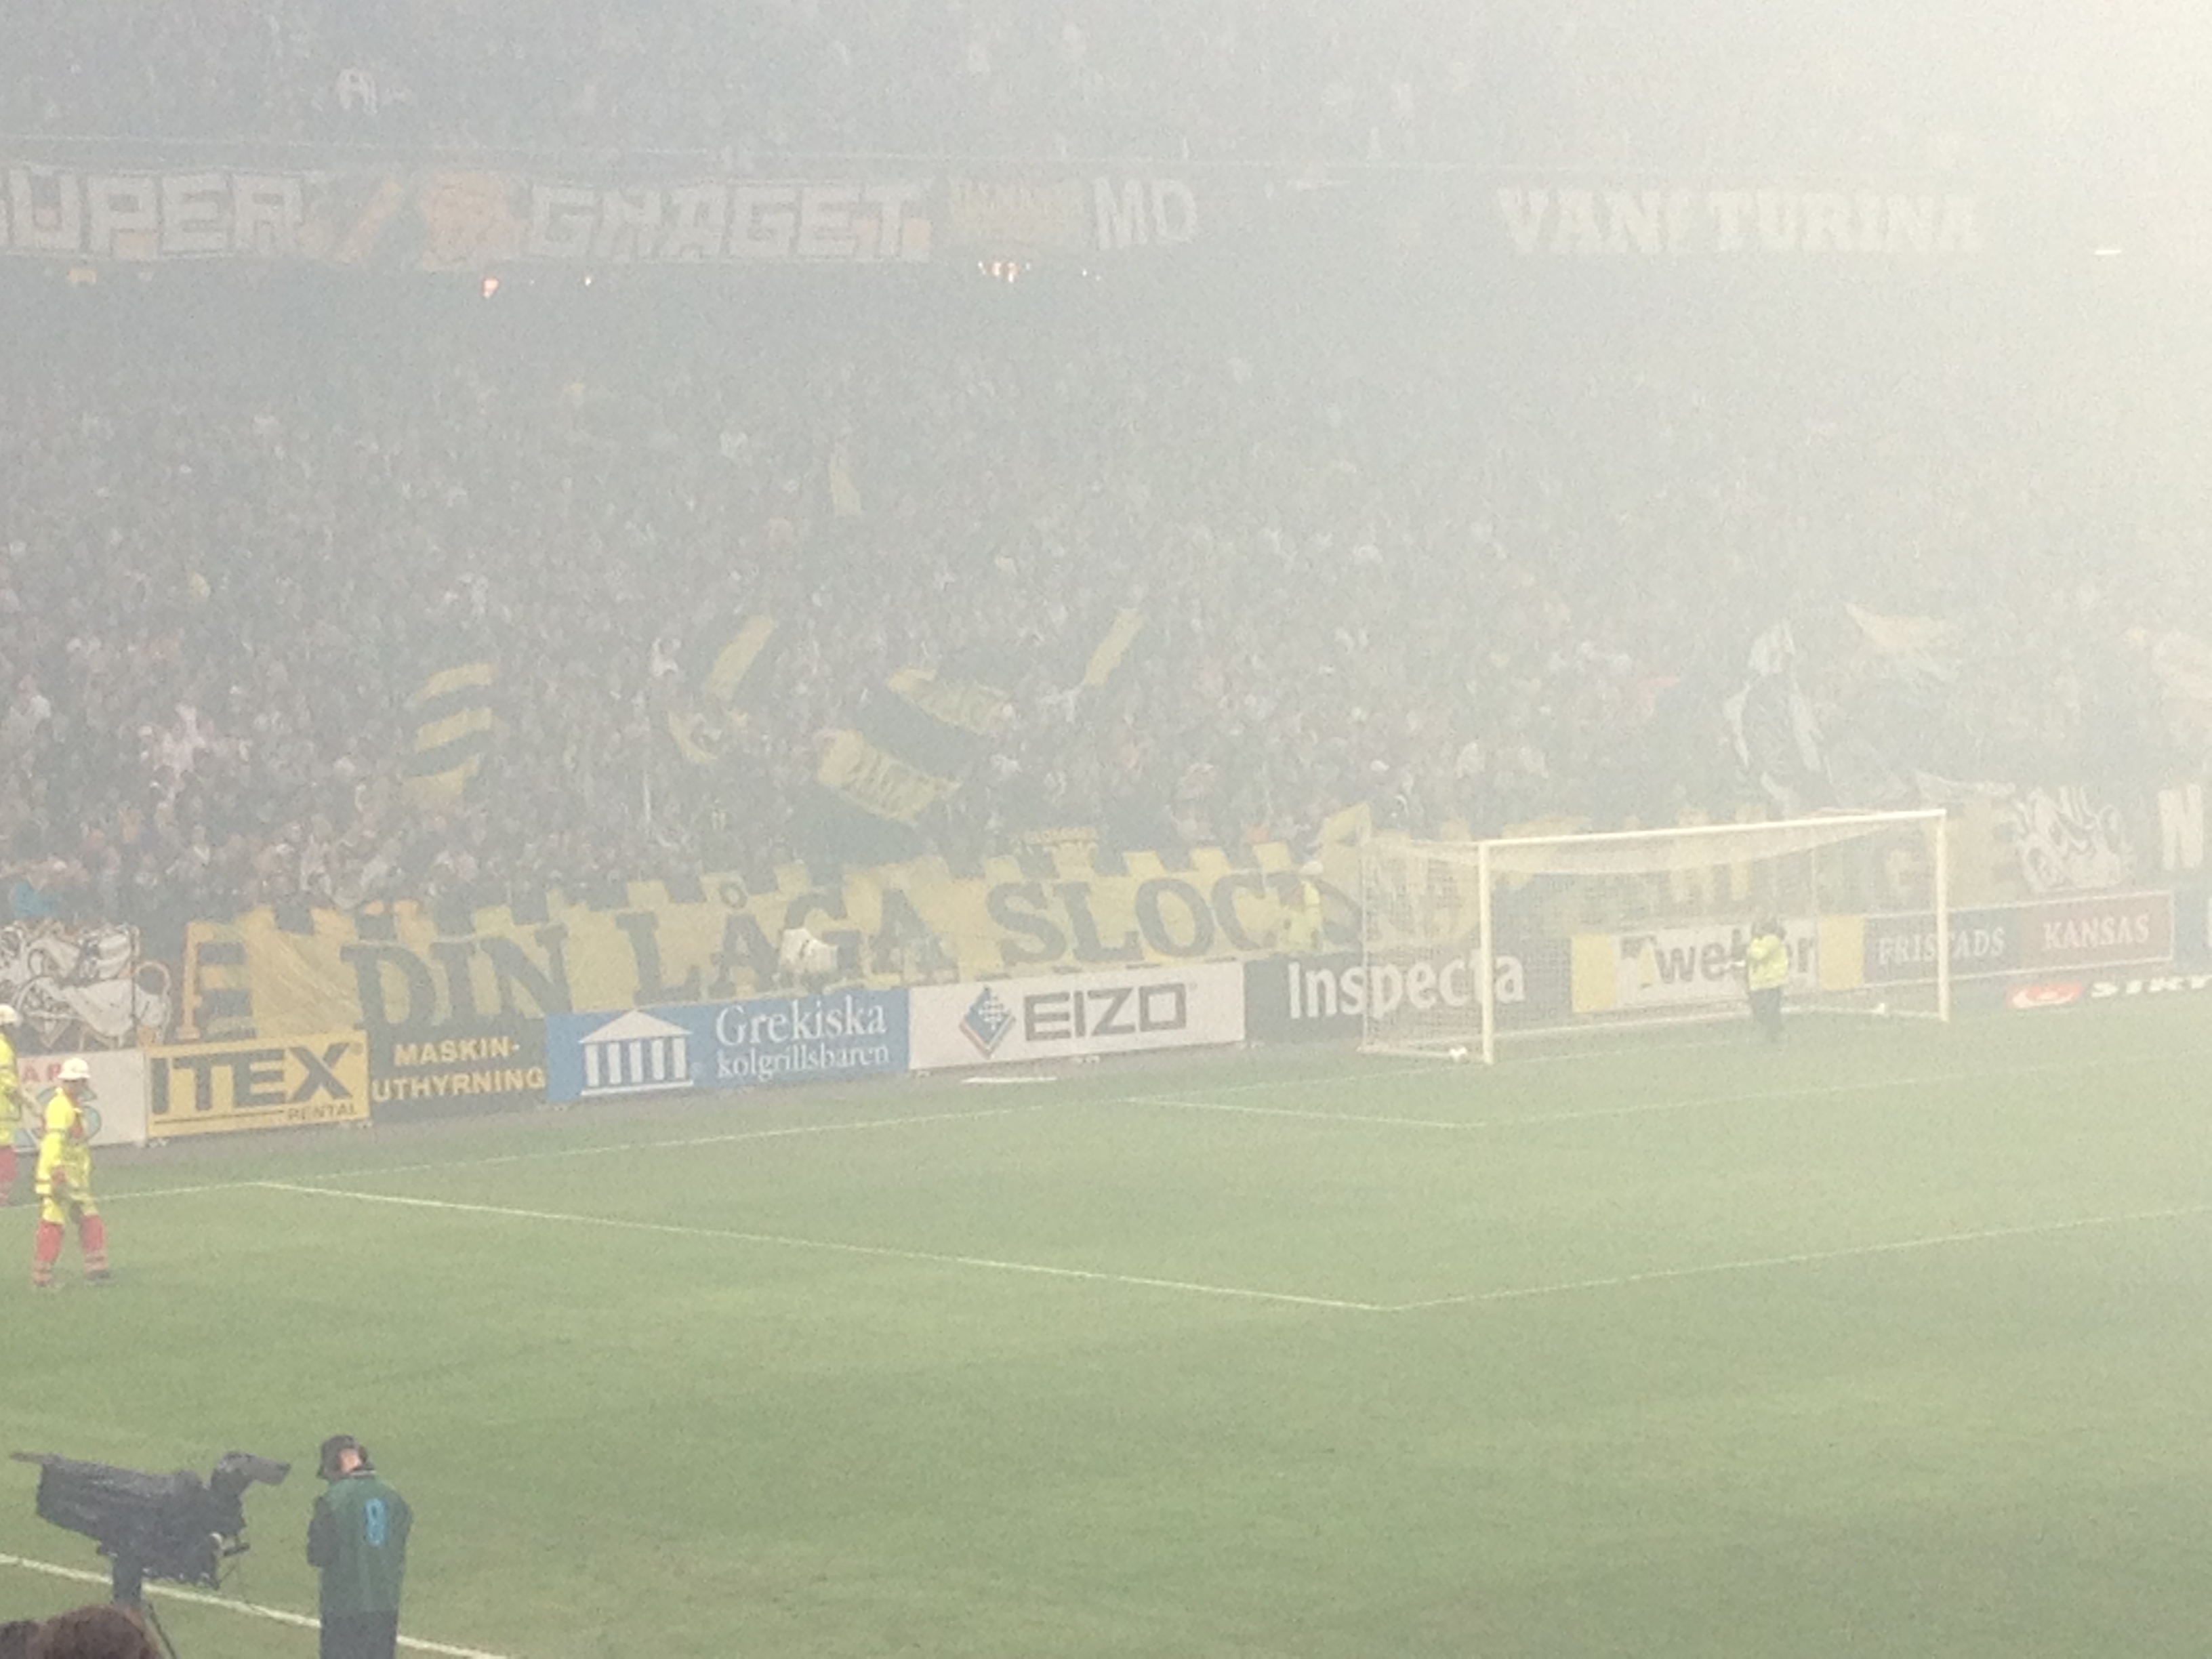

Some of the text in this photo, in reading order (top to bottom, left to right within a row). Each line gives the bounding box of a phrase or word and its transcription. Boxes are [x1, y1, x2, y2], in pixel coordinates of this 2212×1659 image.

[0, 168, 305, 258] UPER
[1654, 927, 1818, 985] wer
[2043, 914, 2150, 951] KANSAS
[341, 924, 573, 1031] DIN
[716, 993, 888, 1046] Grekiska
[1023, 983, 1187, 1042] EIZO
[150, 1042, 353, 1115] ITEX
[394, 1035, 520, 1067] MASKIN-
[716, 1042, 890, 1082] kolgrillsbaren
[371, 1066, 547, 1103] UTHYRNING
